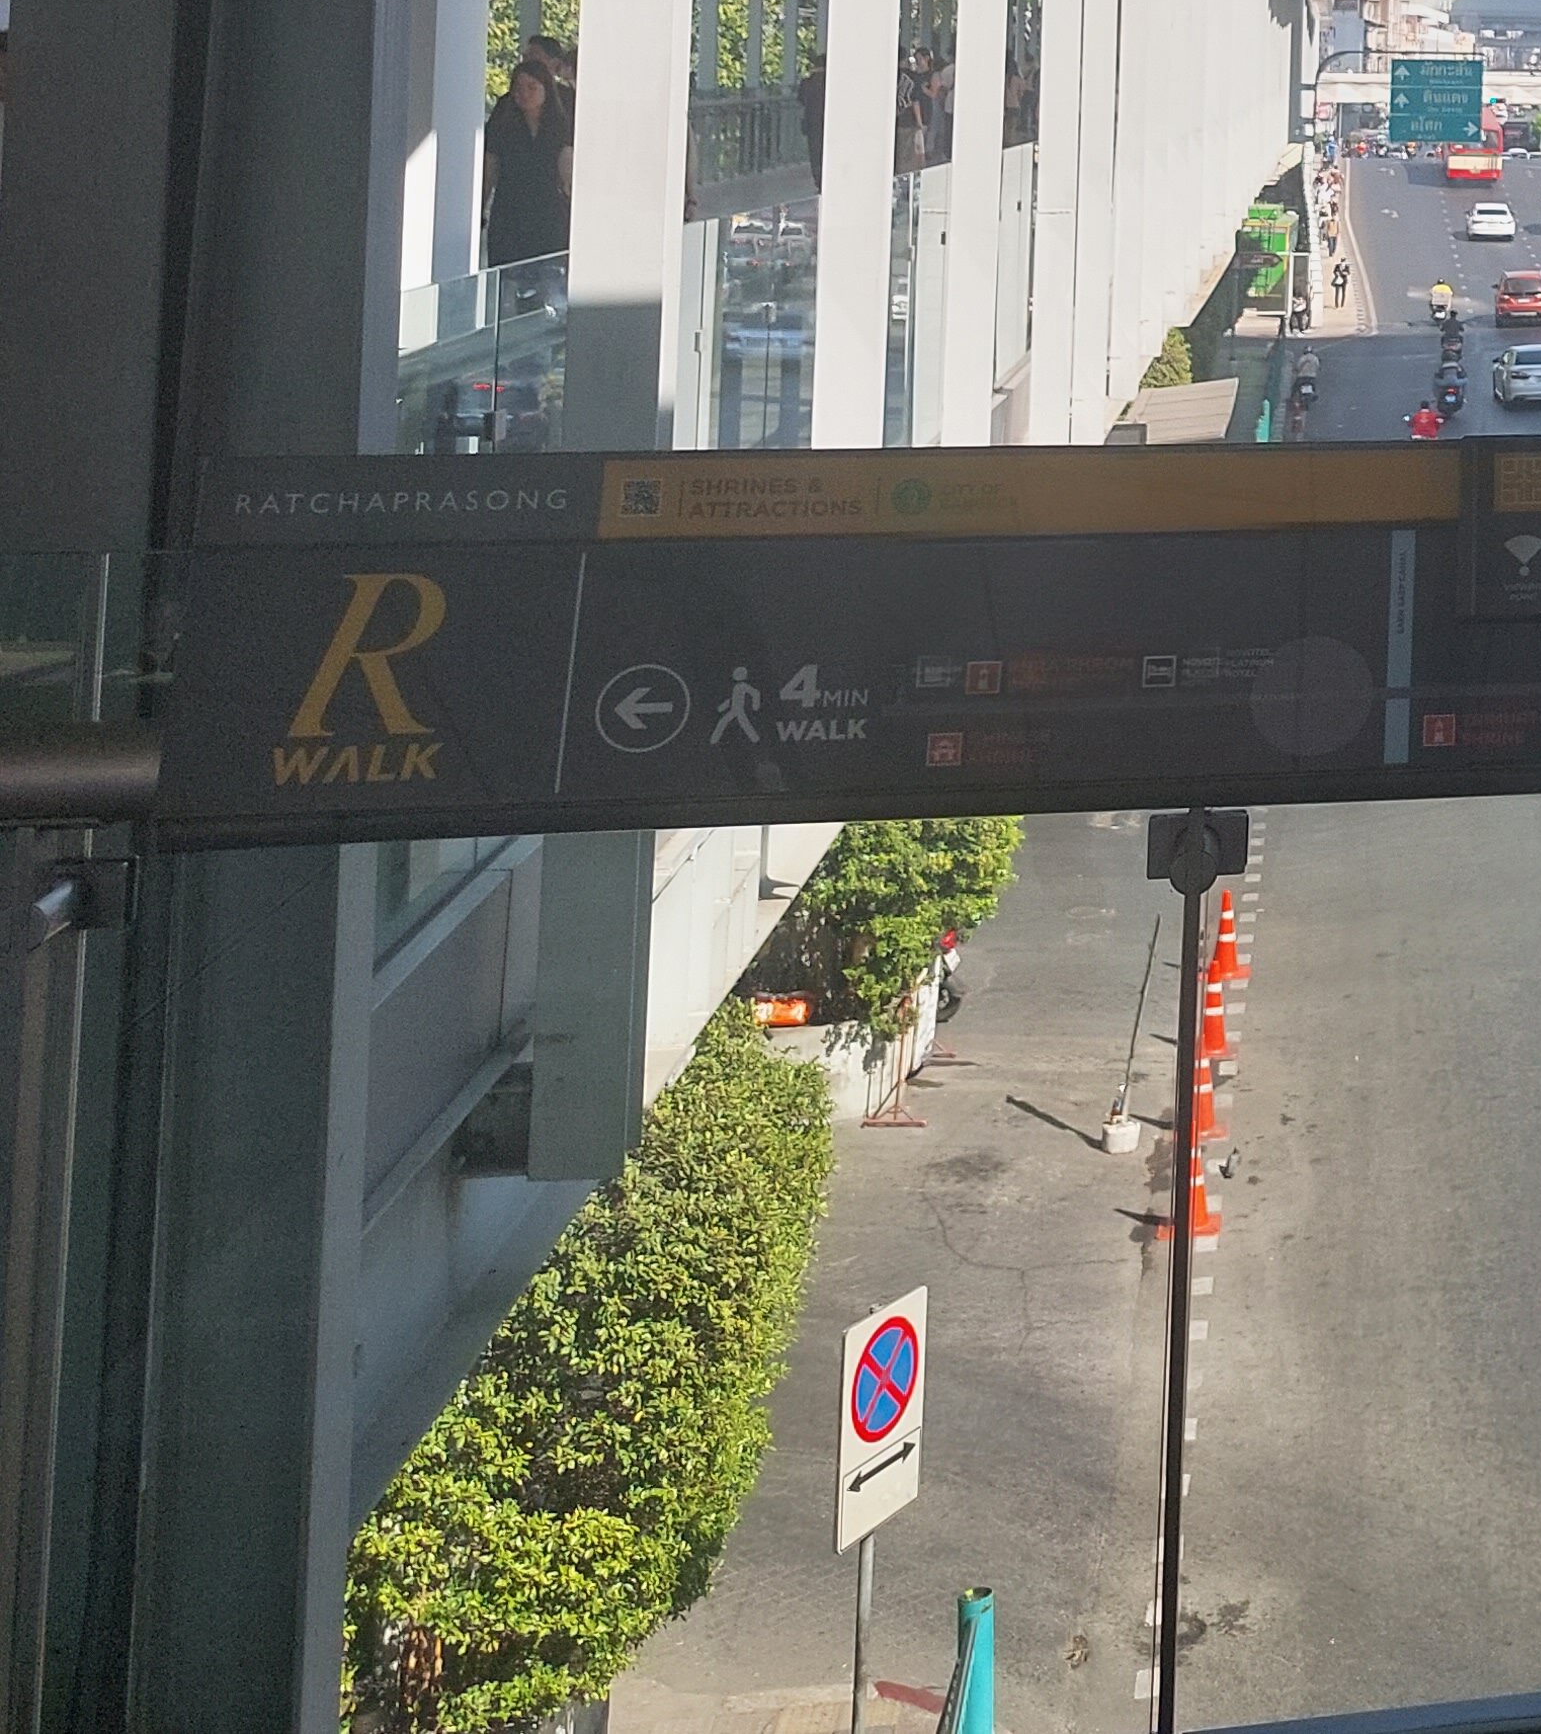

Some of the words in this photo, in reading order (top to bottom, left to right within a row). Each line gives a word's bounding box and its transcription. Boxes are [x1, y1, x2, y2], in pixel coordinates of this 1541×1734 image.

[689, 477, 799, 497] SHRINES
[808, 476, 824, 495] &
[234, 487, 570, 516] RATCHAPRASONG
[687, 497, 864, 520] ATTRACTIONS
[287, 571, 448, 740] R
[779, 664, 822, 708] 4
[822, 687, 870, 709] MIN
[775, 718, 869, 743] WALK
[271, 740, 445, 787] WALK
